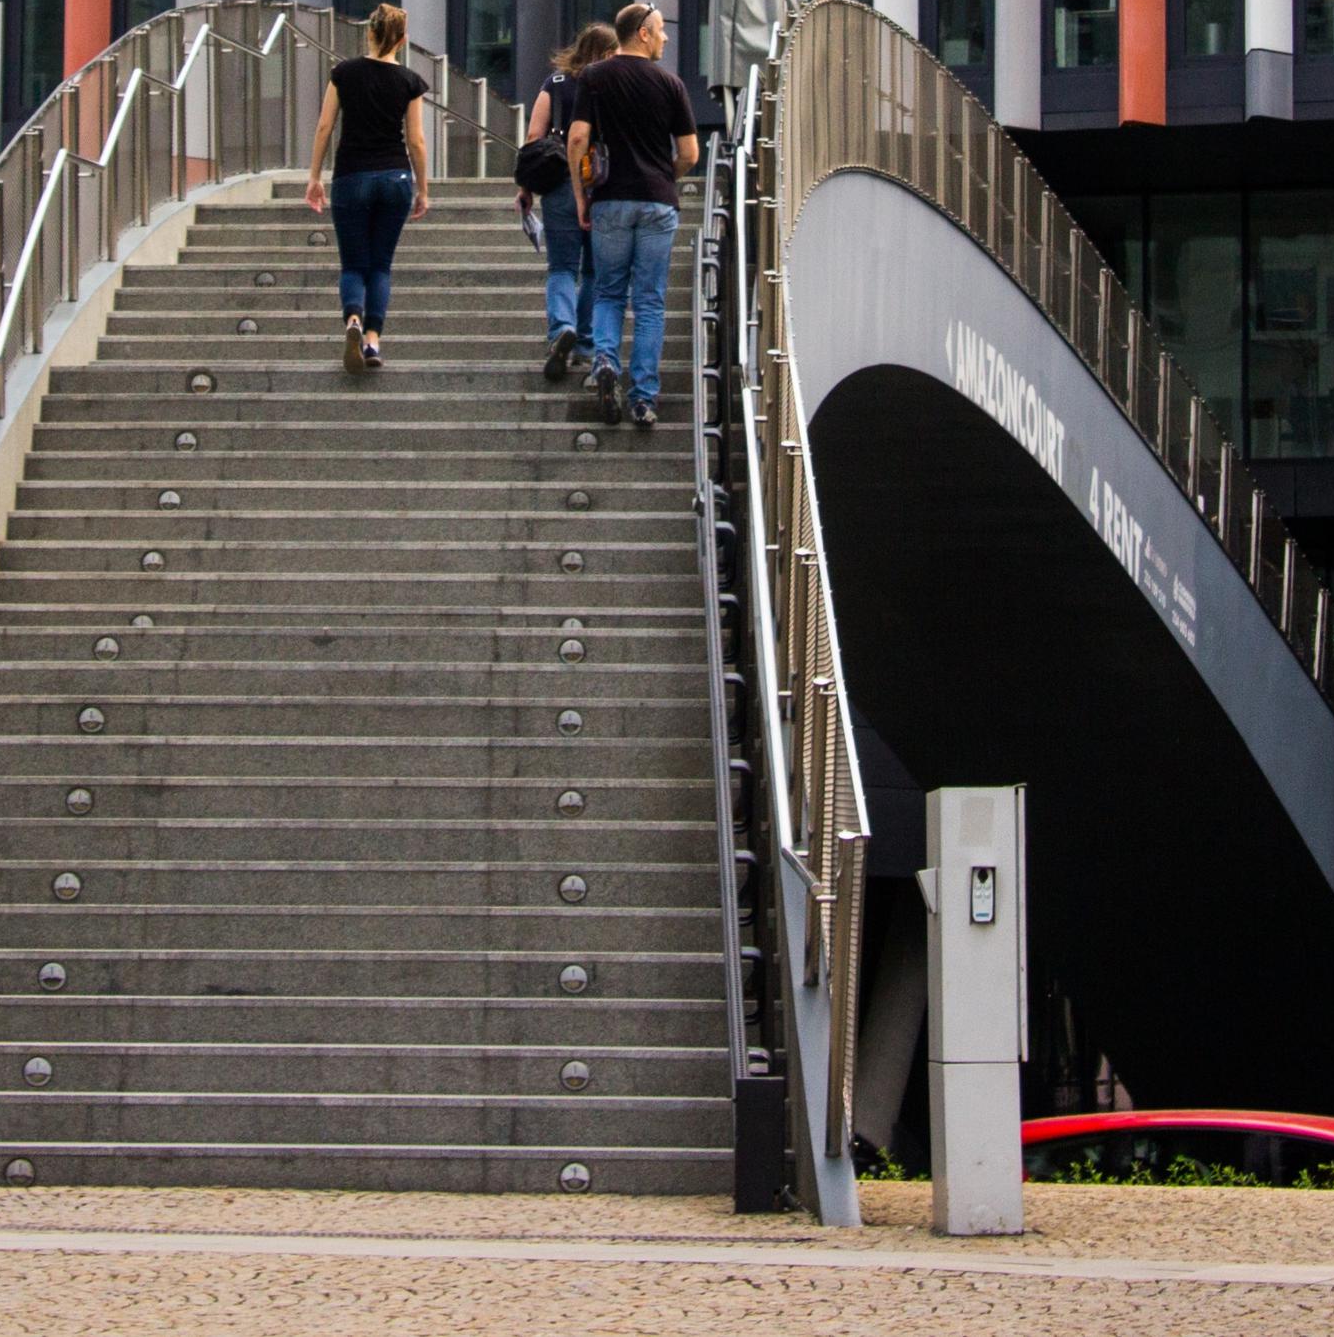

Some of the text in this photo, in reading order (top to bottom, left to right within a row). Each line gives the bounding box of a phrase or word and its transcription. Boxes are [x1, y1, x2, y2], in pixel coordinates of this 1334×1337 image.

[955, 320, 1143, 585] AMAZONCOURT 4 RENT
